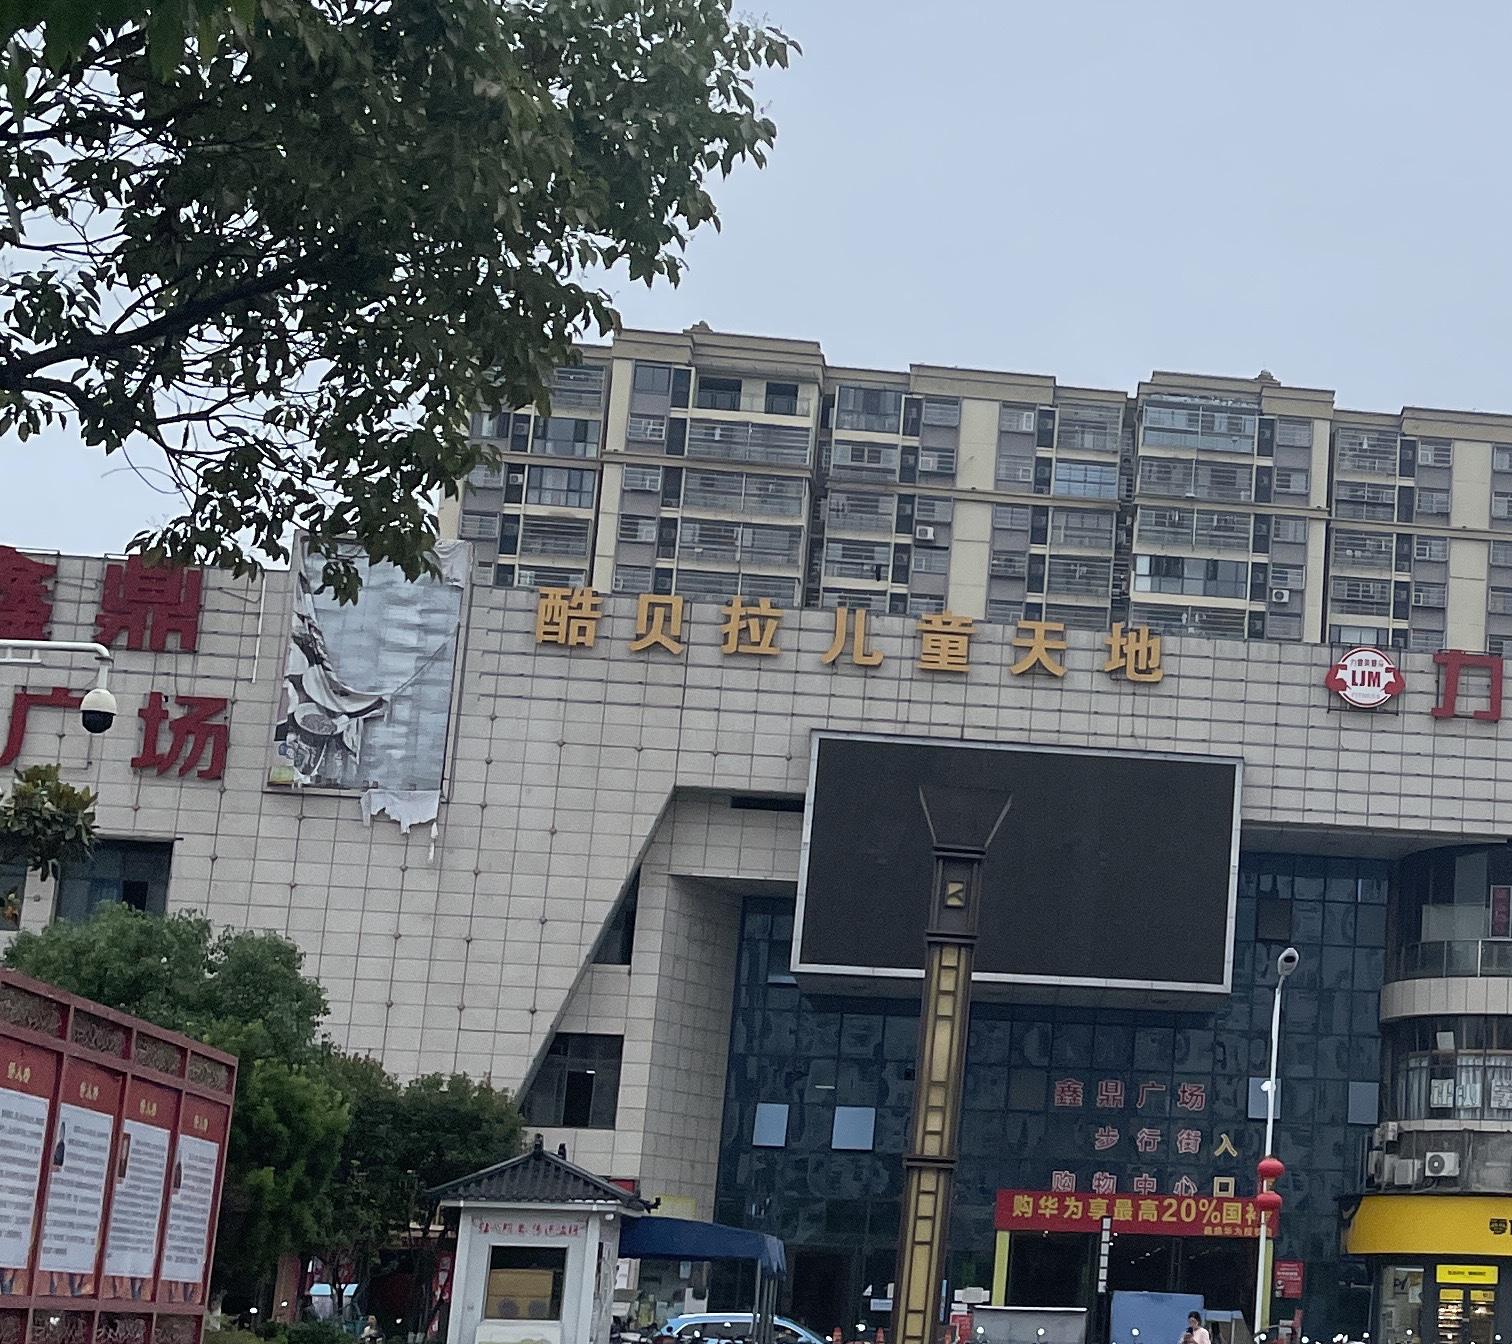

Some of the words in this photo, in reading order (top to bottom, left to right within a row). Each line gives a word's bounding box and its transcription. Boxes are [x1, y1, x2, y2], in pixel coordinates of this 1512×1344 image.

[537, 586, 1163, 683] 酷贝拉儿童天地
[1351, 669, 1382, 689] LJM
[1054, 1077, 1207, 1112] 鑫鼎广场
[1094, 1125, 1203, 1155] 步行街
